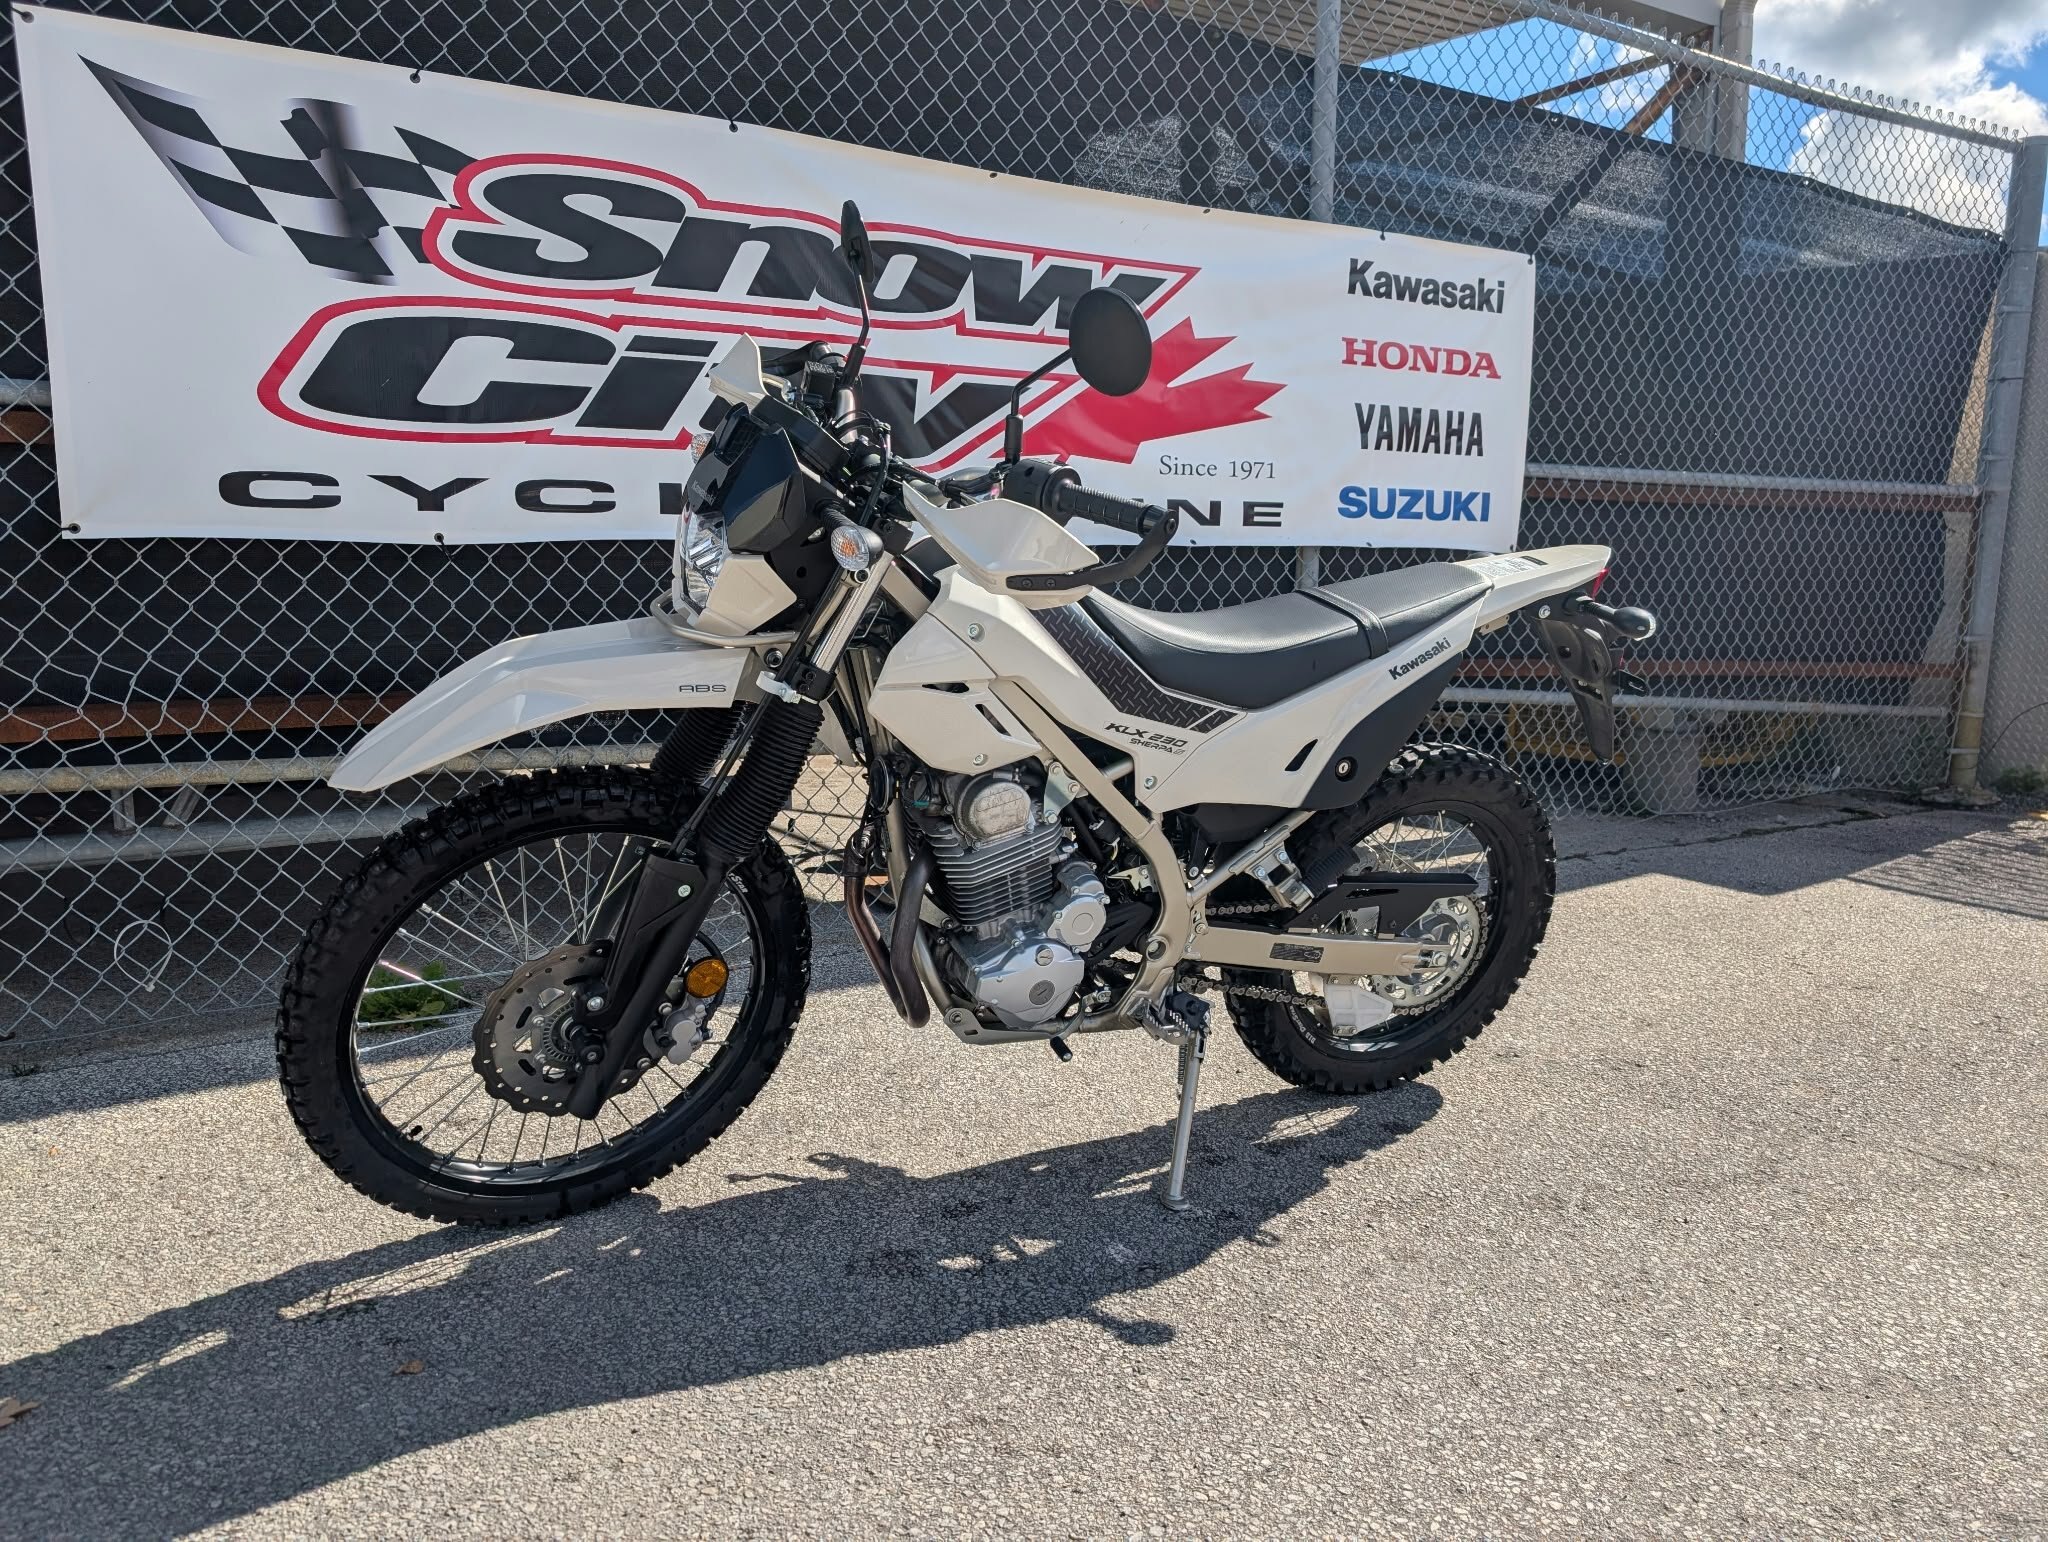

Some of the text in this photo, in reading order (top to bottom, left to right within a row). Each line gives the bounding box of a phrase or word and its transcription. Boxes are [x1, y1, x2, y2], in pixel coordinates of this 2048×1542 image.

[452, 174, 1165, 330] Snow
[1348, 258, 1505, 314] Kawasaki
[1342, 337, 1501, 379] HONDA
[299, 316, 1031, 458] Ciy
[1354, 402, 1484, 456] YAMAHA
[1159, 455, 1275, 480] Since 1971
[218, 470, 682, 515] CYC
[1337, 486, 1491, 522] SUZUKI
[1388, 637, 1451, 680] Kawasaki
[1104, 723, 1188, 747] KLX 230
[1129, 738, 1173, 753] SHERPA
